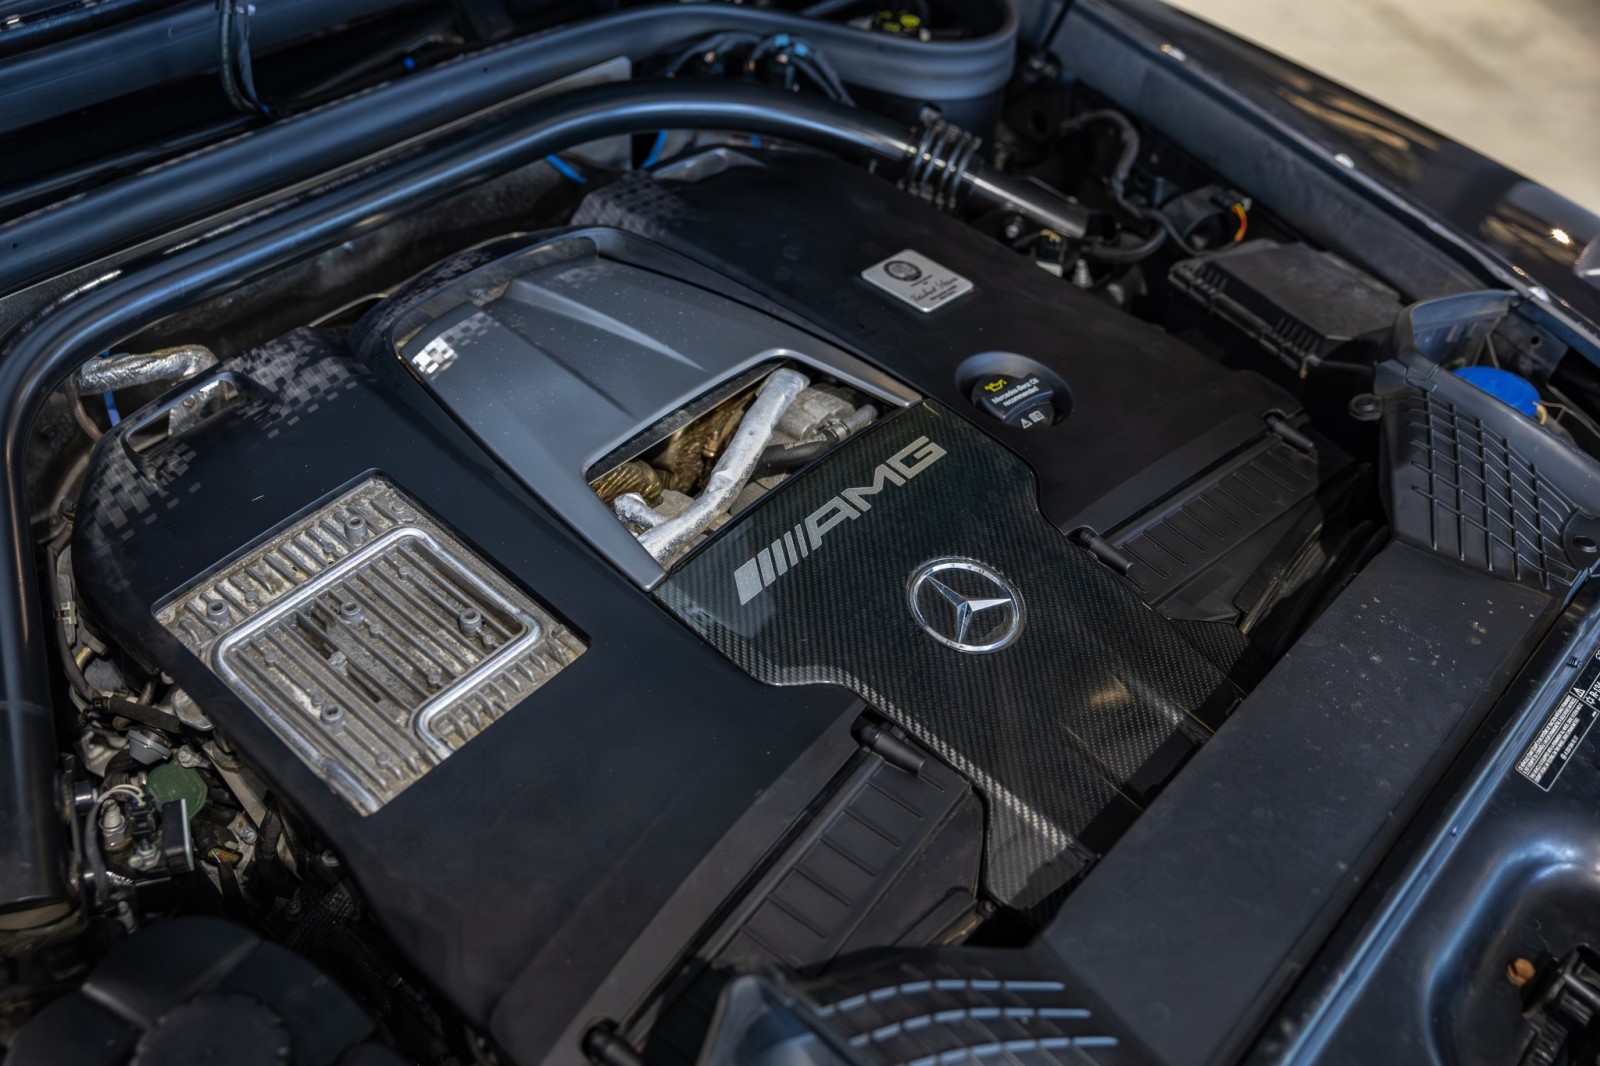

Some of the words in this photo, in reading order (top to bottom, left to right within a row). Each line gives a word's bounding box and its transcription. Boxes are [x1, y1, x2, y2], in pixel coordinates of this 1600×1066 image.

[991, 382, 1032, 404] Mercedes-Benz
[1029, 377, 1040, 385] Oil
[1003, 385, 1040, 407] recommended
[805, 435, 947, 550] AMG
